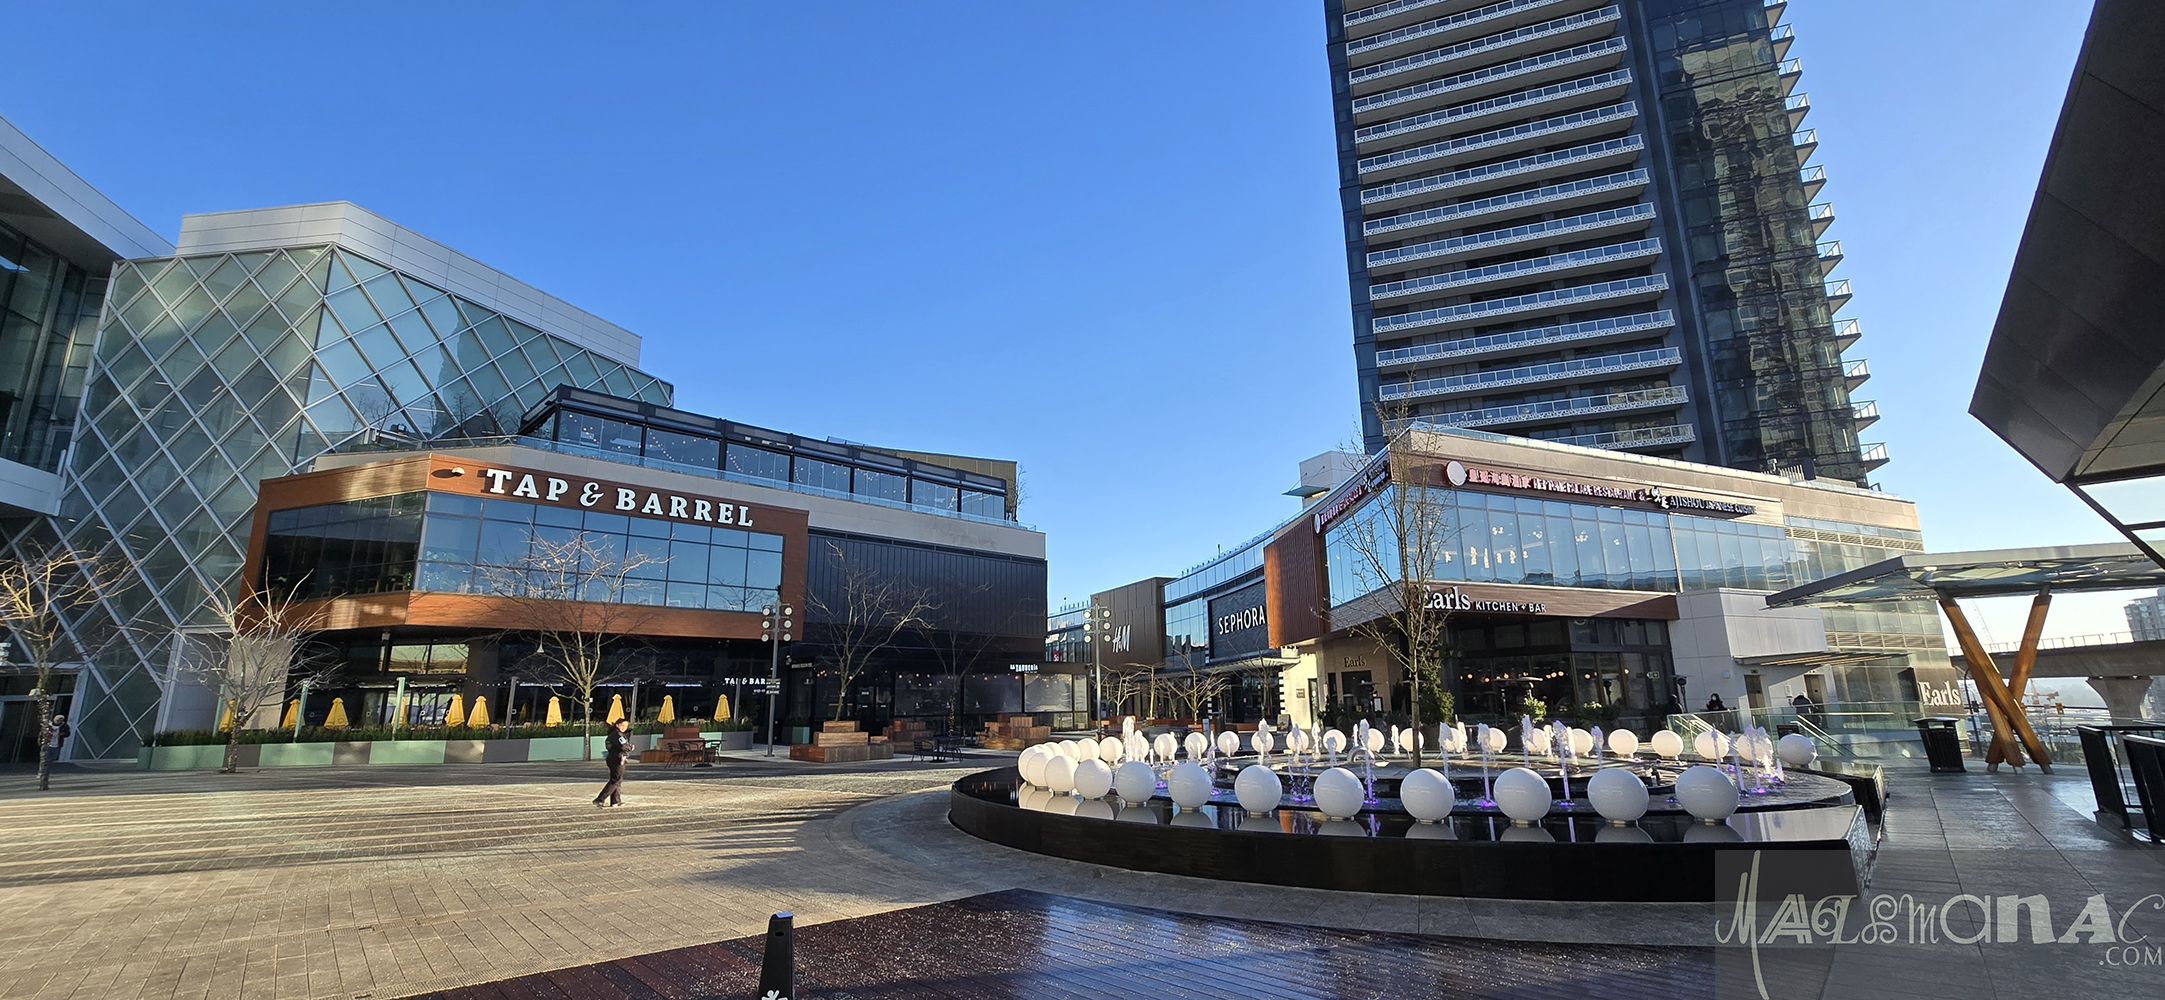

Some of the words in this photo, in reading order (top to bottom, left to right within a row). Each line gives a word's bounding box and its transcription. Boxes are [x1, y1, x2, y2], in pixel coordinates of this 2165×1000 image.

[486, 468, 568, 501] TAP
[579, 482, 604, 507] &
[615, 487, 753, 527] BARREL
[1416, 584, 1471, 610] Earls
[1475, 600, 1519, 612] KITCHEN
[1528, 603, 1547, 613] BAR
[1218, 605, 1266, 635] SEPHORA
[1112, 625, 1131, 653] H&M
[1344, 656, 1367, 668] Earls
[1918, 680, 1961, 706] Earls
